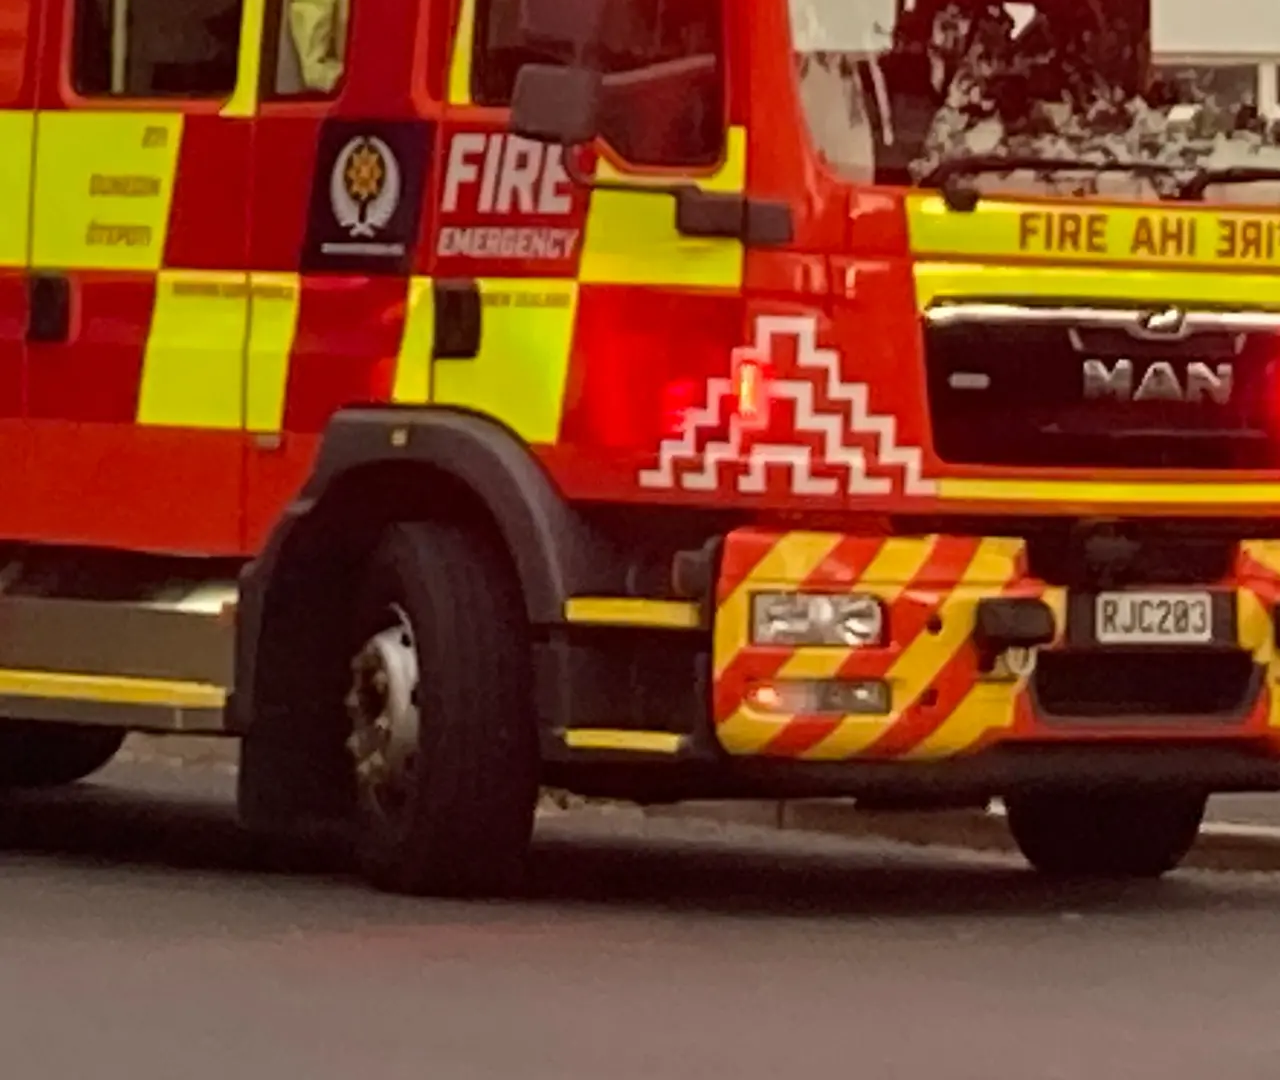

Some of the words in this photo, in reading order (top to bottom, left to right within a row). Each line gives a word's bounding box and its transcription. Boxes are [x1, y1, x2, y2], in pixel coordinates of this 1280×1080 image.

[441, 133, 573, 215] FIRE
[437, 226, 580, 260] EMERGENCY
[1019, 212, 1108, 253] FIRE
[1130, 215, 1197, 257] AHI
[1082, 358, 1233, 404] MAN
[1101, 599, 1207, 634] RJC203
